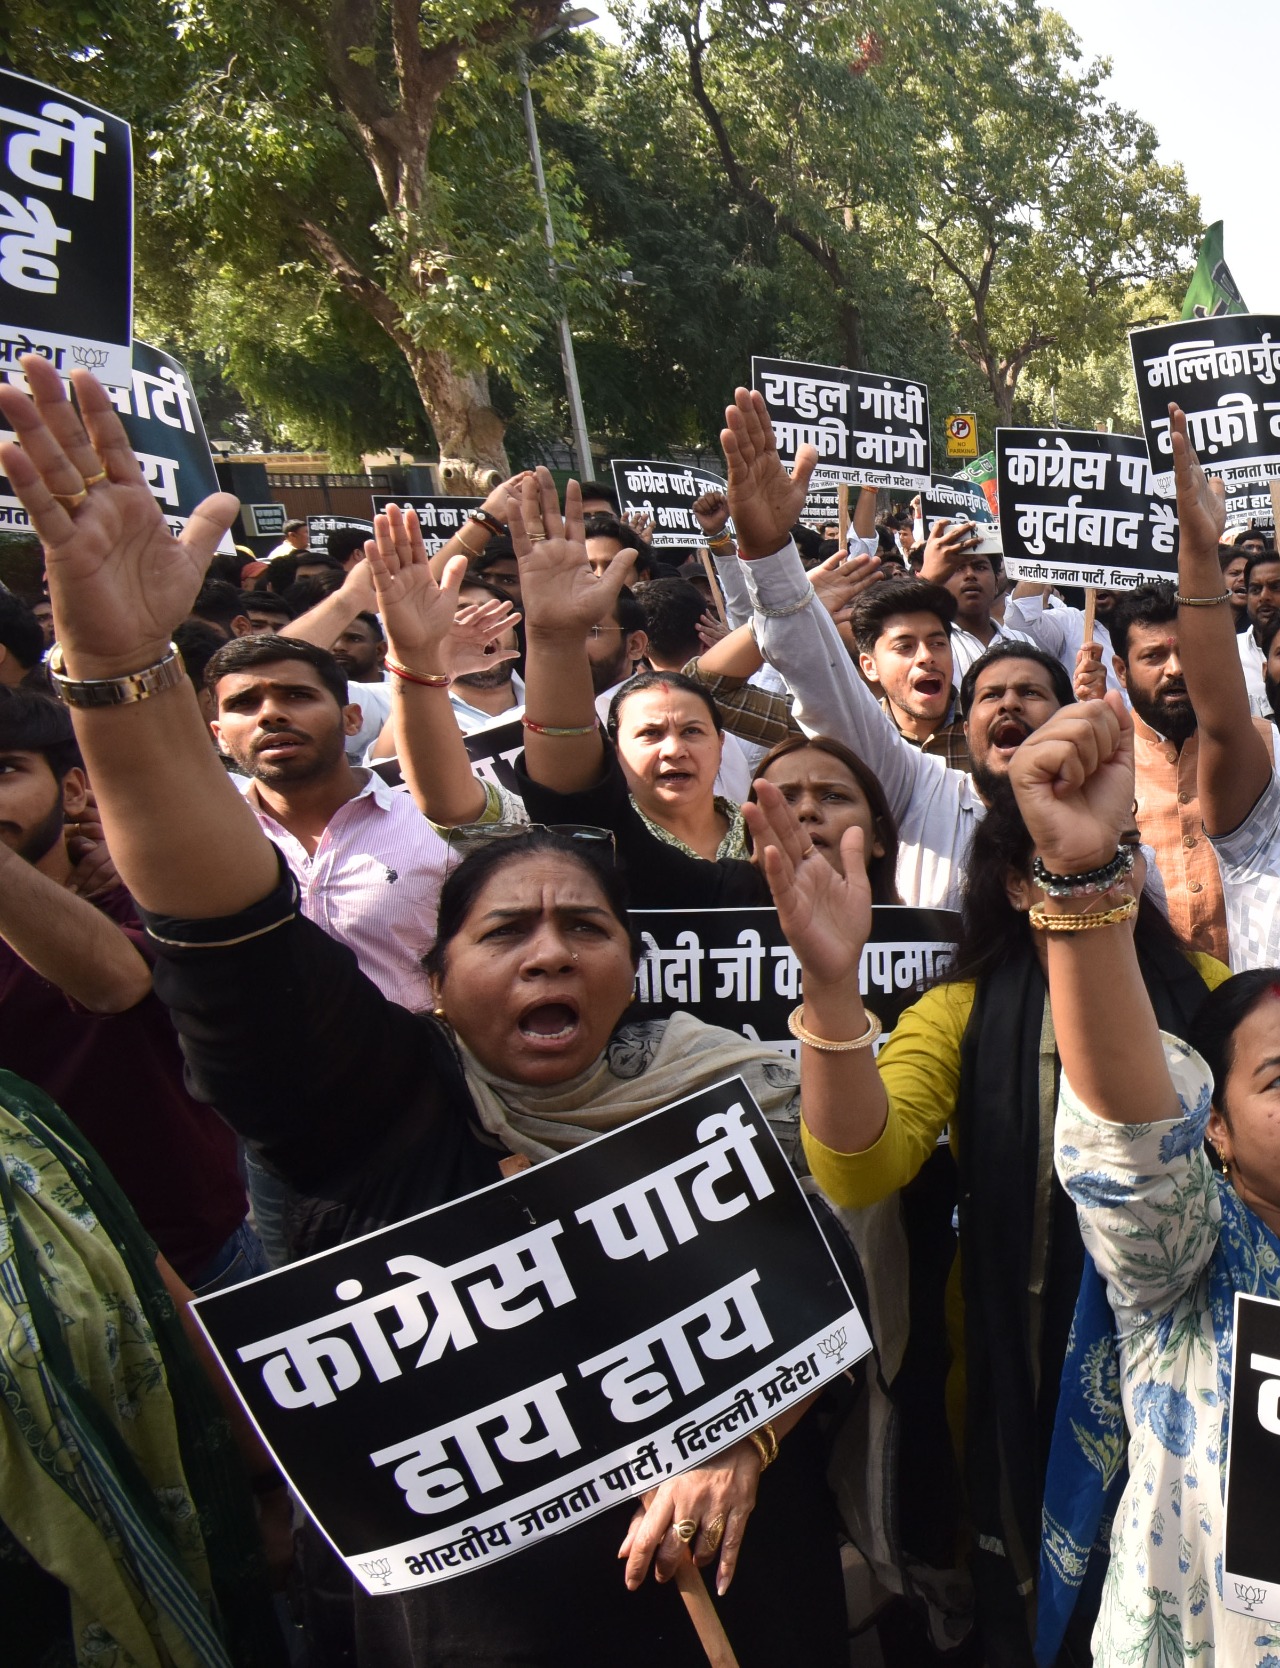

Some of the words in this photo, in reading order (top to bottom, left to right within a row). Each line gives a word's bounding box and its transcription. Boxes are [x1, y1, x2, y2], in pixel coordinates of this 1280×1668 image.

[761, 373, 850, 419] राहुल
[858, 382, 925, 425] गांधी
[853, 426, 927, 468] मांगो
[1005, 438, 1111, 490] कांग्रेस
[624, 465, 669, 493] कांग्रेस
[668, 470, 697, 496] पार्टी
[814, 469, 840, 480] जनता
[842, 471, 863, 483] पार्टी,
[865, 472, 891, 485] दिल्ली
[893, 476, 913, 487] प्रदेश
[1225, 465, 1261, 480] जनता
[419, 503, 438, 527] जी
[438, 509, 458, 527] का
[926, 484, 981, 513] मल्लिकार्जुन
[658, 507, 690, 529] भाषा
[1015, 495, 1144, 554] मुर्दाबाद
[1149, 502, 1179, 553] है
[676, 537, 697, 545] जनता
[1018, 564, 1048, 579] भारतीय
[1050, 569, 1078, 581] जनता
[1081, 570, 1107, 586] पार्टी,
[1110, 571, 1144, 587] दिल्ली
[710, 928, 765, 1001] जी
[236, 1218, 578, 1411] कांग्रेस
[575, 1102, 775, 1262] पार्टी
[369, 1373, 582, 1516] हाय
[578, 1269, 775, 1424] हाय
[405, 1528, 511, 1578] भारतीय
[511, 1479, 601, 1538] जनता
[601, 1441, 673, 1495] पार्टी,
[672, 1391, 759, 1457] दिल्ली
[758, 1352, 821, 1415] प्रदेश
